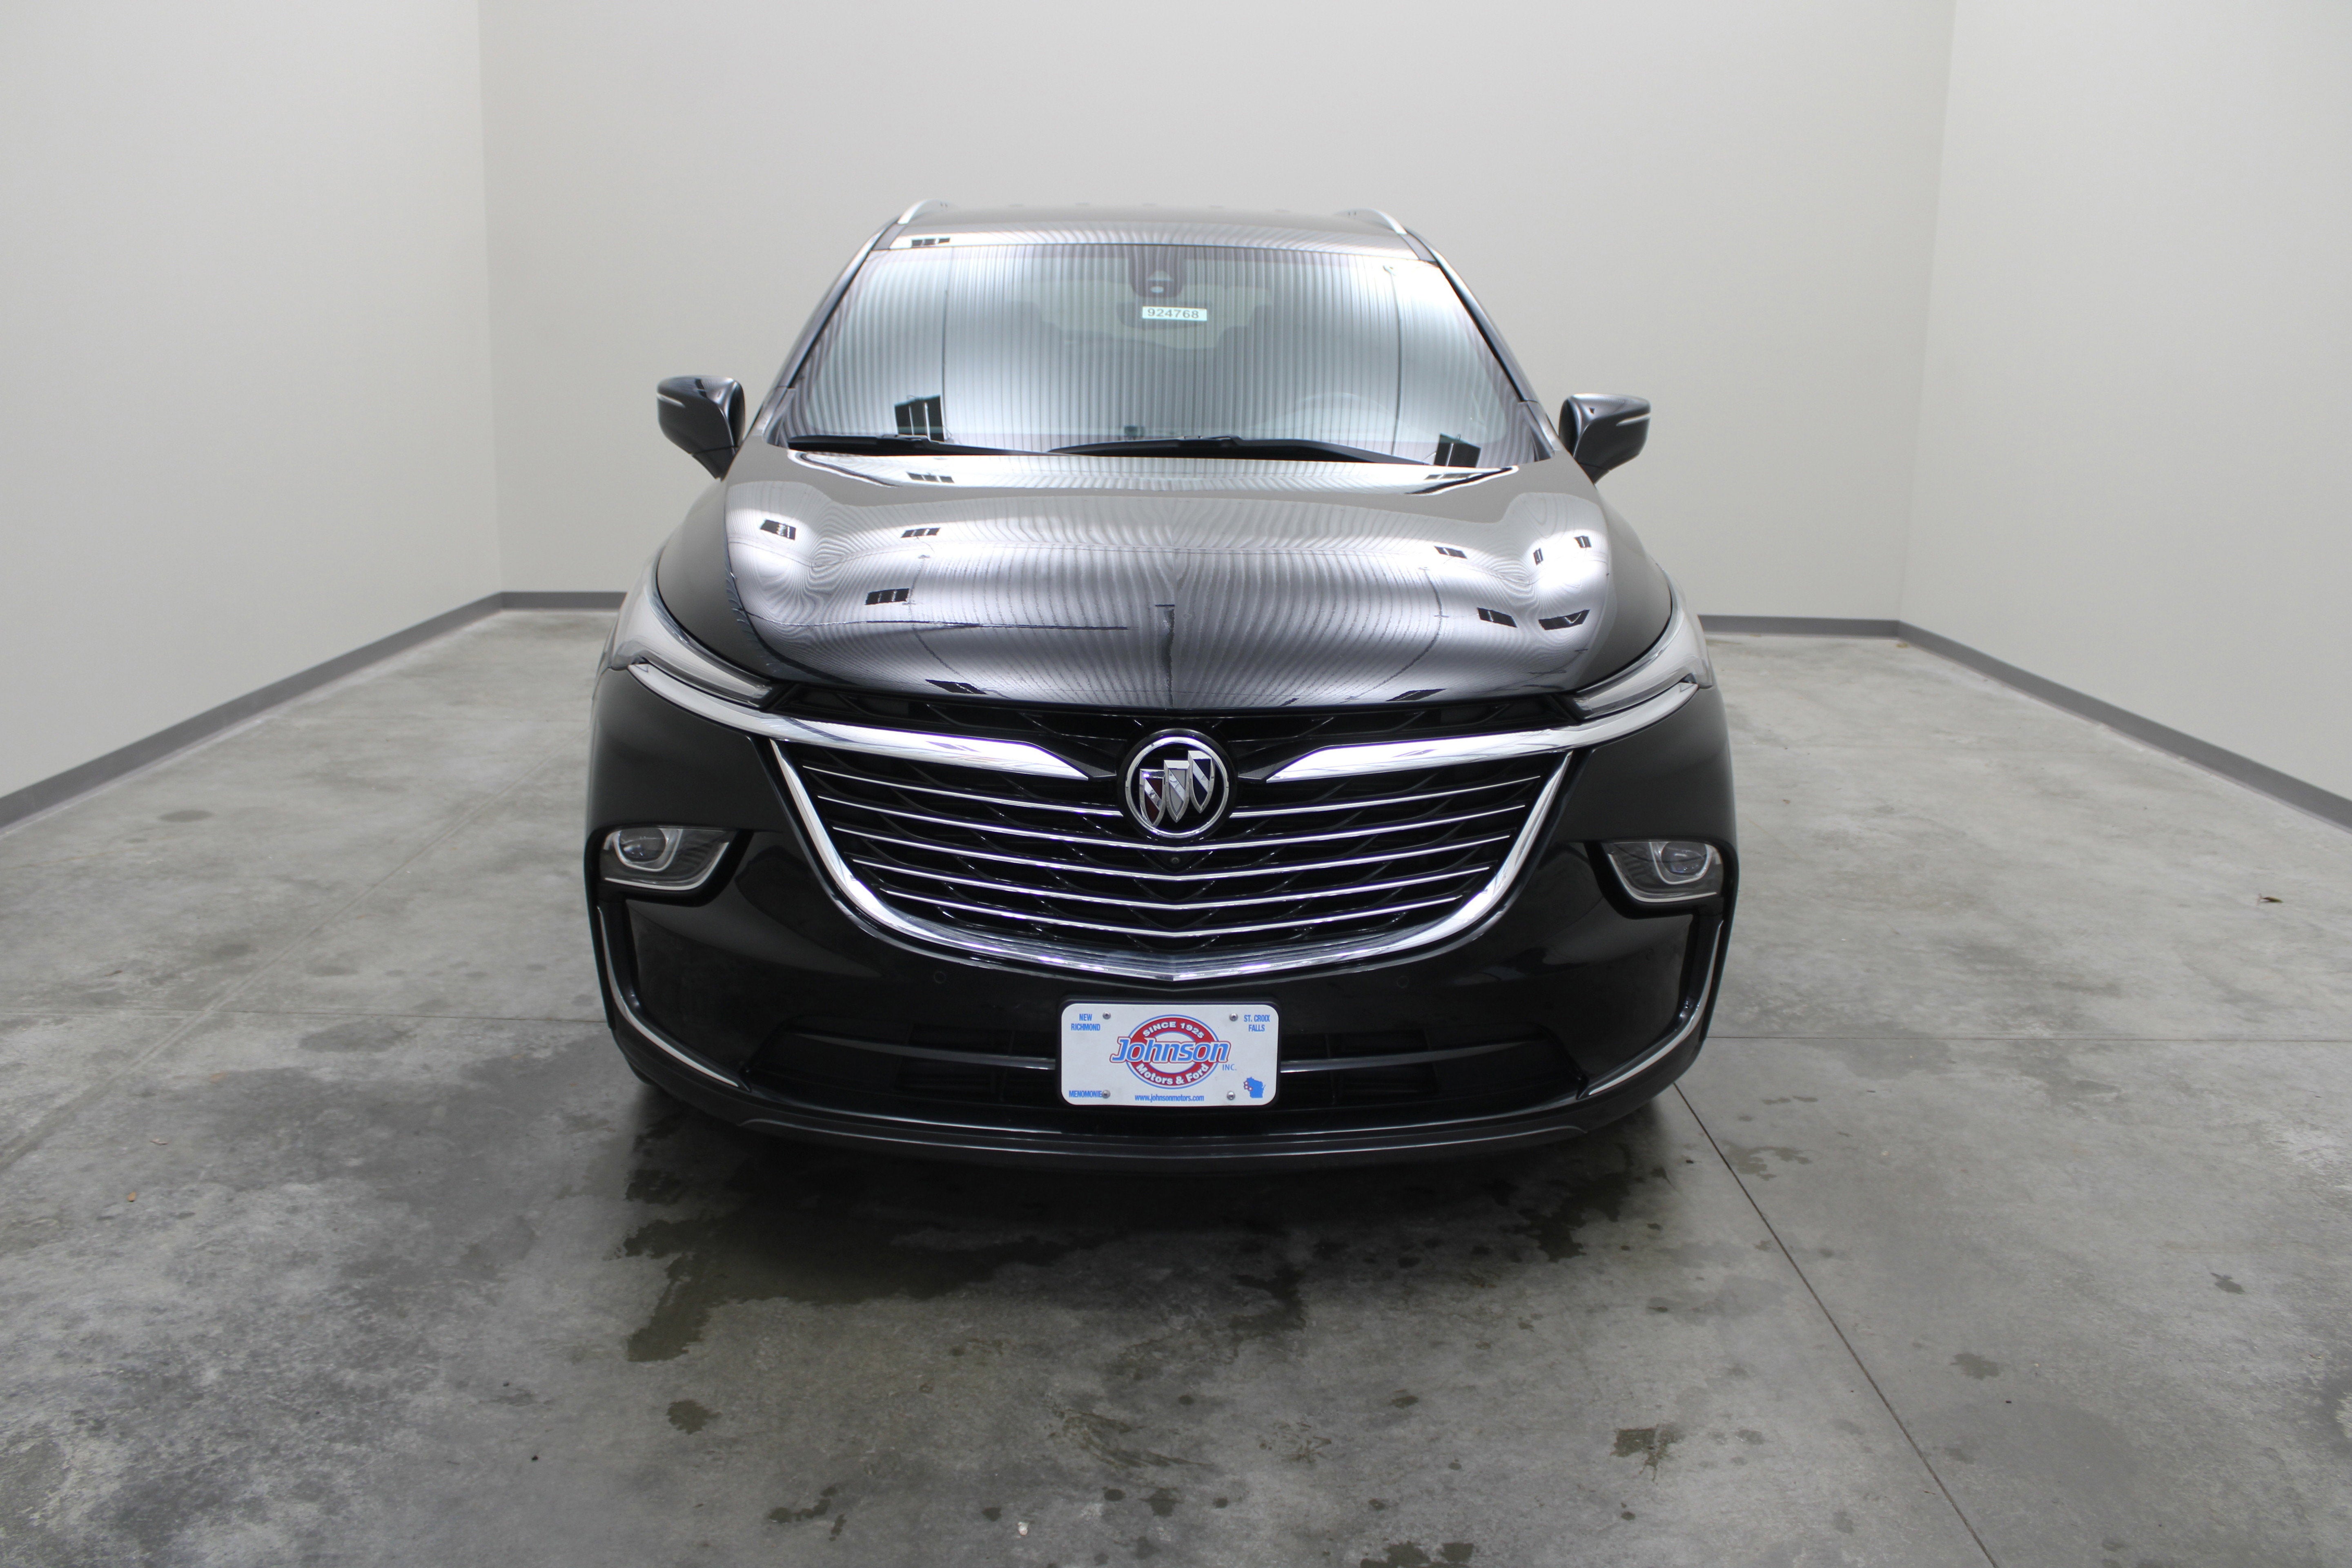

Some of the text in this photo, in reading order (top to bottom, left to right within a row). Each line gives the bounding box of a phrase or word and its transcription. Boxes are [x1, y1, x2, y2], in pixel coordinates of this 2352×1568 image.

[1147, 308, 1199, 319] 924768
[1143, 1021, 1205, 1039] SINCE 1925
[1111, 1037, 1230, 1062] Johnson
[1136, 1063, 1209, 1085] Motors & Ford
[1135, 1094, 1204, 1102] www.johnsonmotors.com
